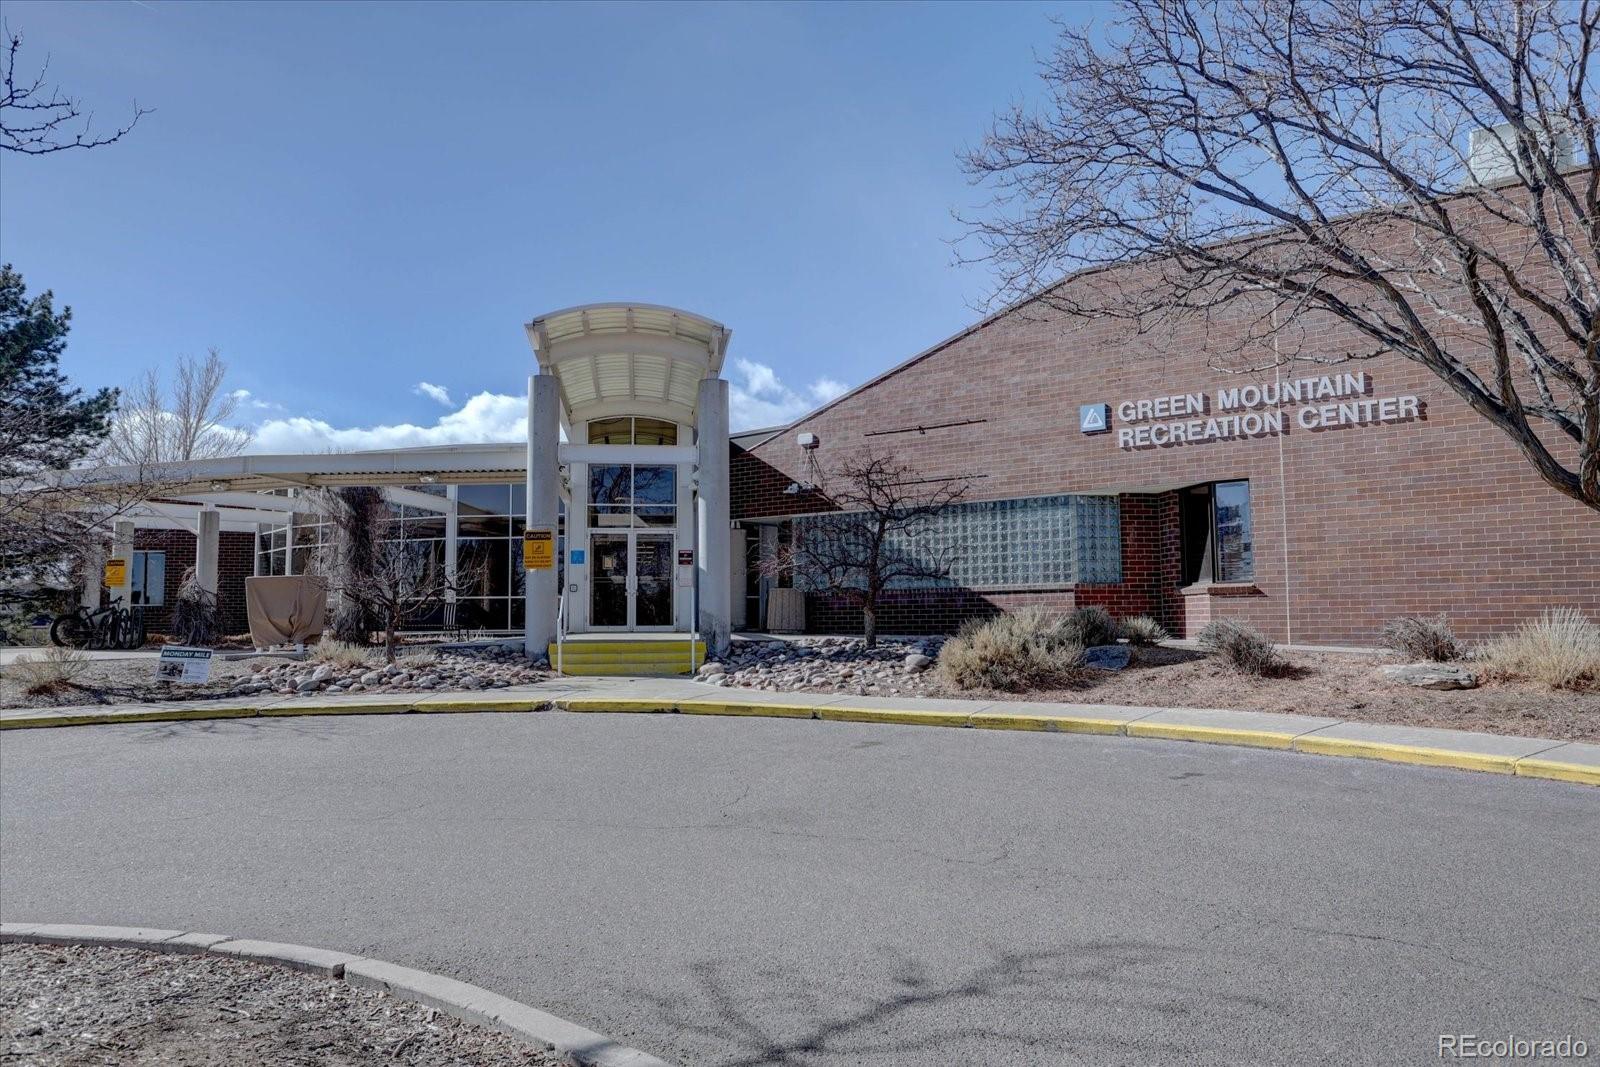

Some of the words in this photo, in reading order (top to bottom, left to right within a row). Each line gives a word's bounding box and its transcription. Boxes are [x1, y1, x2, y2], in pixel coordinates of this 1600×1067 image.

[1118, 392, 1204, 422] GREEN
[1218, 371, 1365, 410] MOUNTAIN
[1118, 411, 1283, 448] RECREATION
[1300, 395, 1419, 429] CENTER
